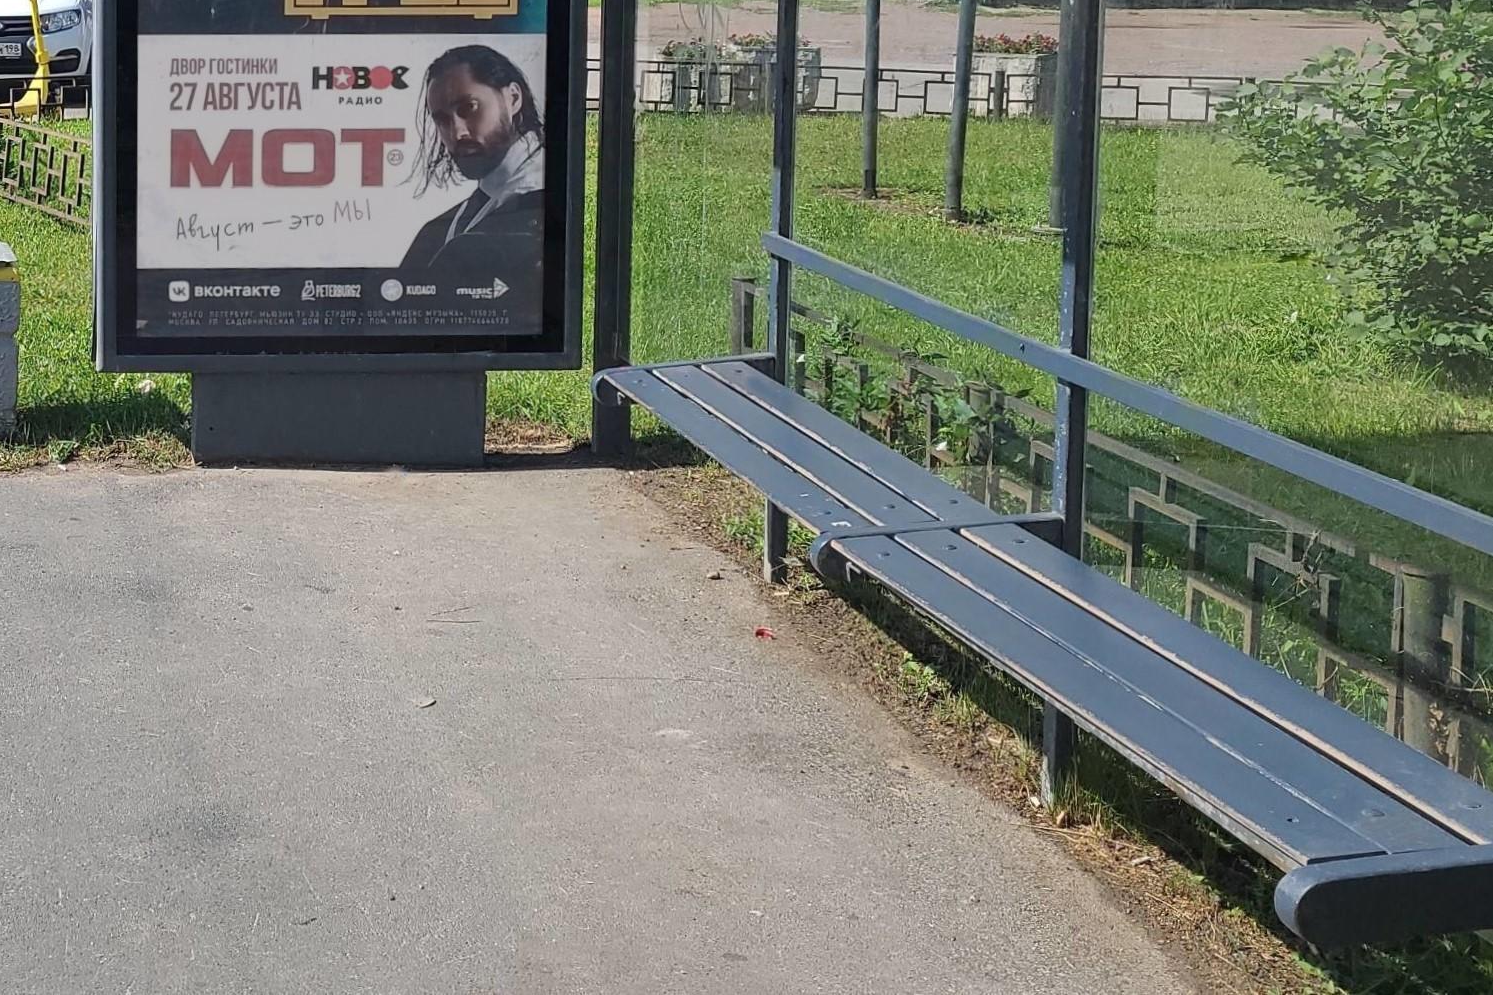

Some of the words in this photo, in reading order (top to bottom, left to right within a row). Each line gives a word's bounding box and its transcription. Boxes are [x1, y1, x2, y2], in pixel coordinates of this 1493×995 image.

[170, 58, 206, 76] ДВОР
[209, 58, 278, 75] ГОСТИНКИ
[170, 82, 198, 111] 27
[202, 82, 302, 111] АВГУСТА
[338, 96, 383, 106] РАДИО
[170, 128, 405, 188] МОТ
[176, 213, 254, 251] Август
[288, 213, 324, 230] это
[333, 198, 372, 223] МЫ
[194, 285, 281, 297] вконтакте
[406, 285, 437, 295] KUDAGO
